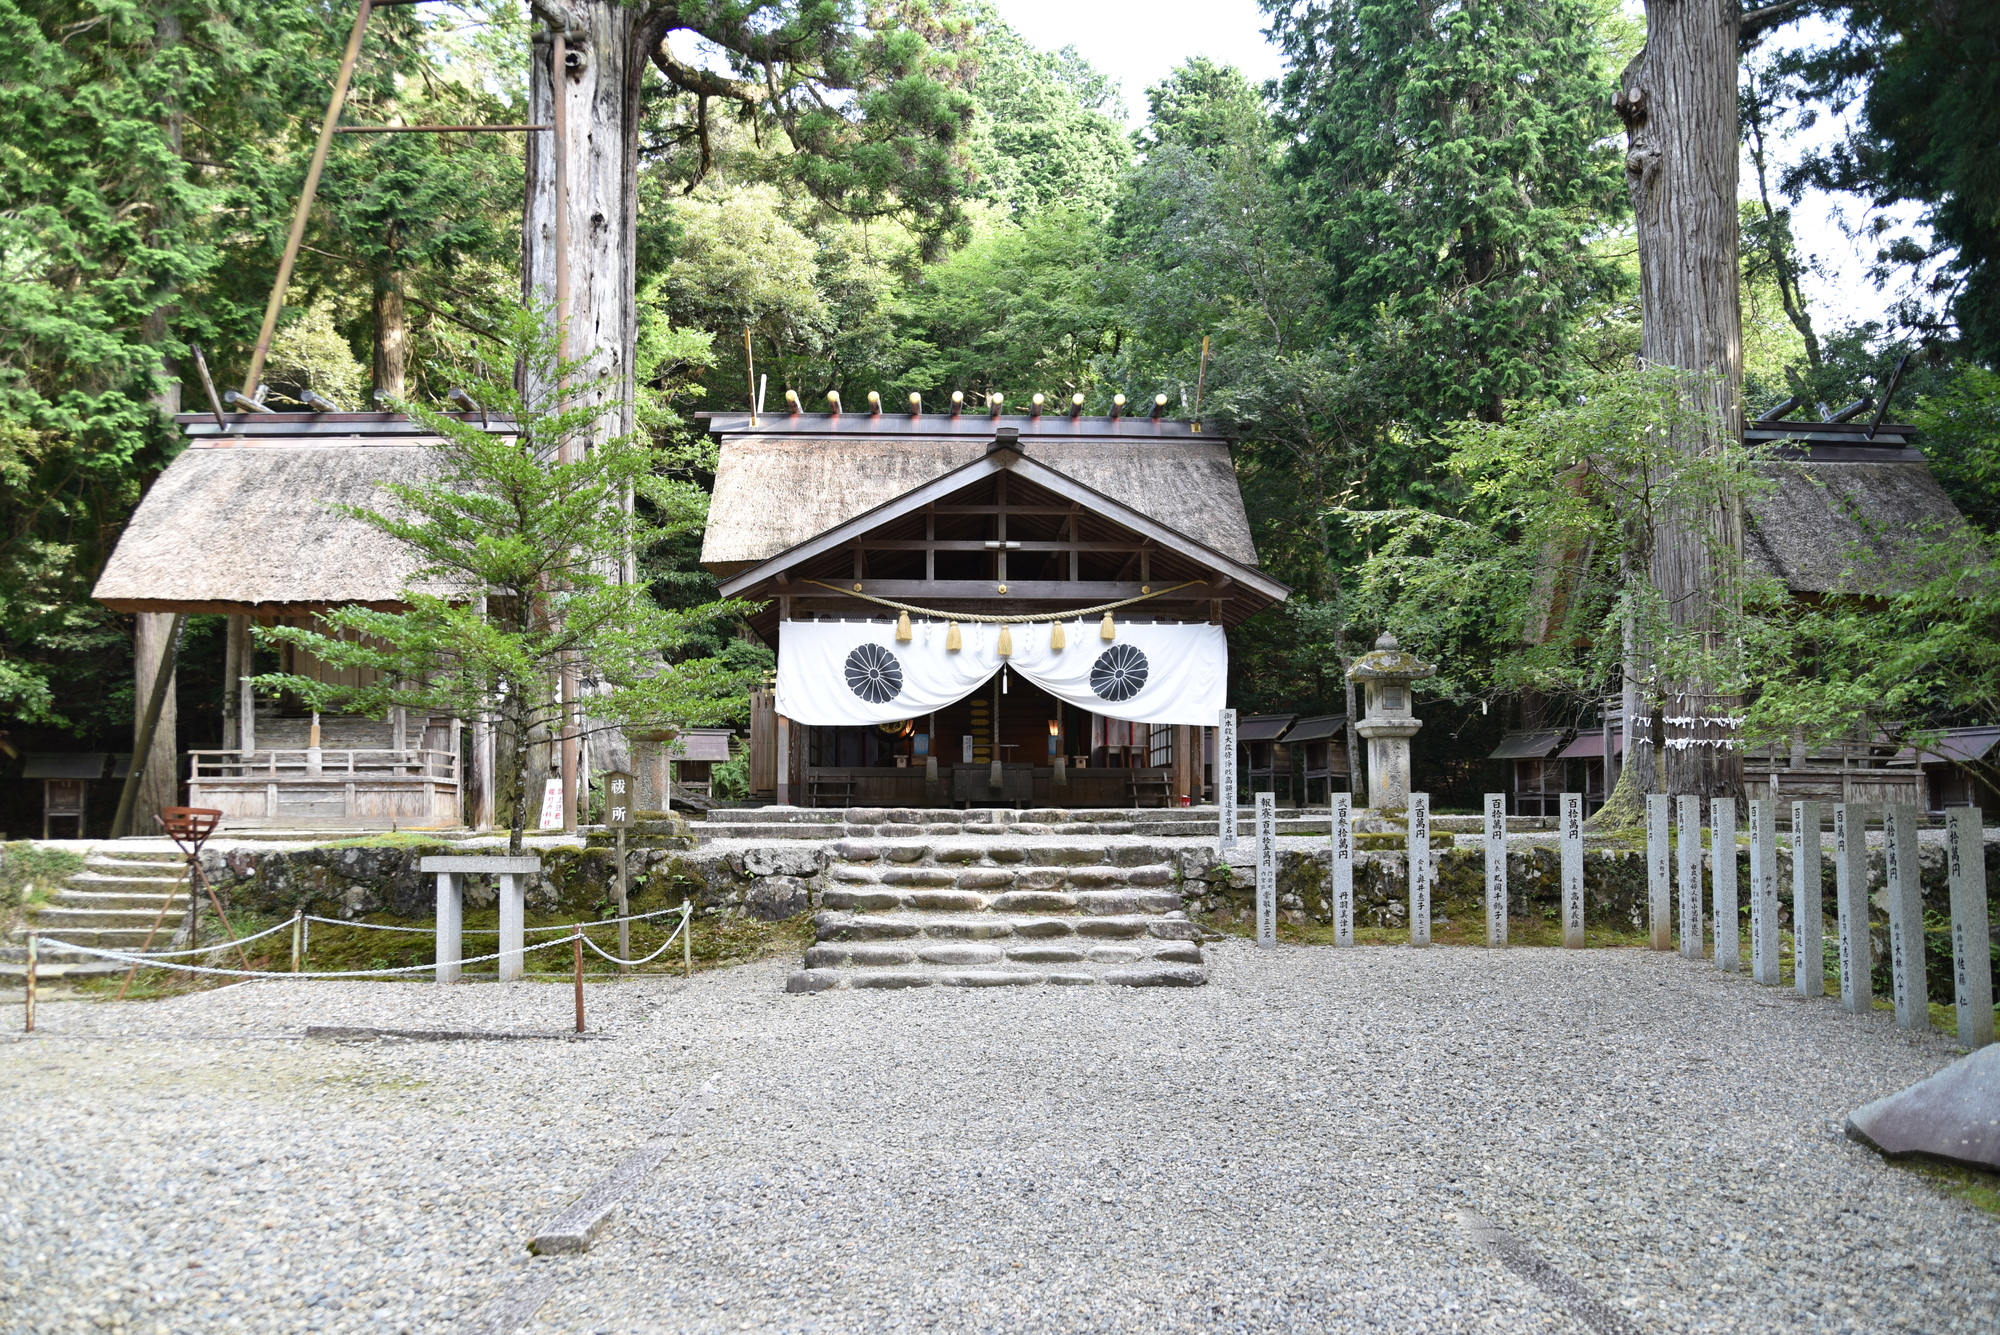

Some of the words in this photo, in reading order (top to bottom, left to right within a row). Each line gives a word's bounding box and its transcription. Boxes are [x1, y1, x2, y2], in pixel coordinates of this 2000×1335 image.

[611, 779, 627, 822] 祓所
[1949, 816, 1960, 878] 六拾萬円
